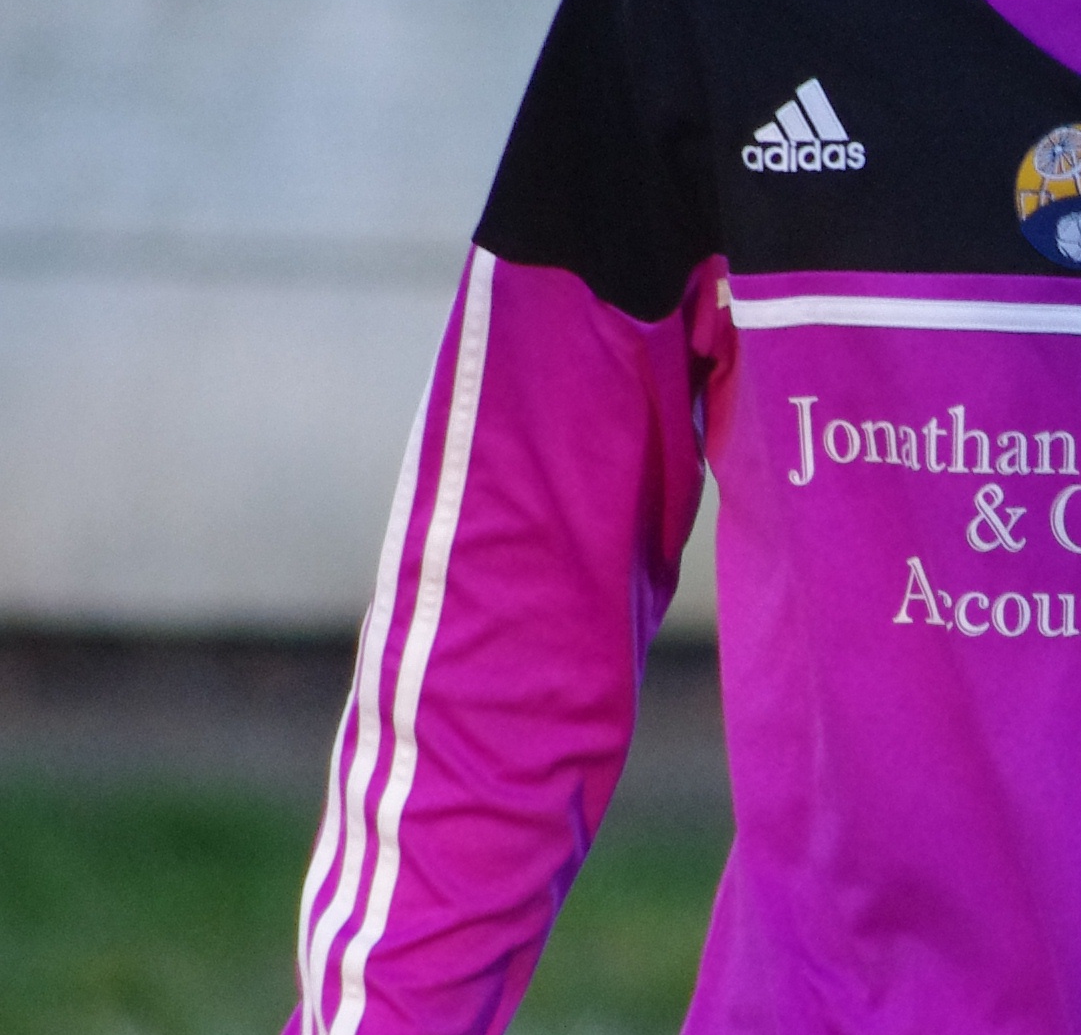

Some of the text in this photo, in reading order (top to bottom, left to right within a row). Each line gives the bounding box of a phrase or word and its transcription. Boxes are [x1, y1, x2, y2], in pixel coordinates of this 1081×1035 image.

[742, 141, 866, 172] adidas
[788, 395, 1079, 487] Jonathan
[966, 483, 1027, 553] &
